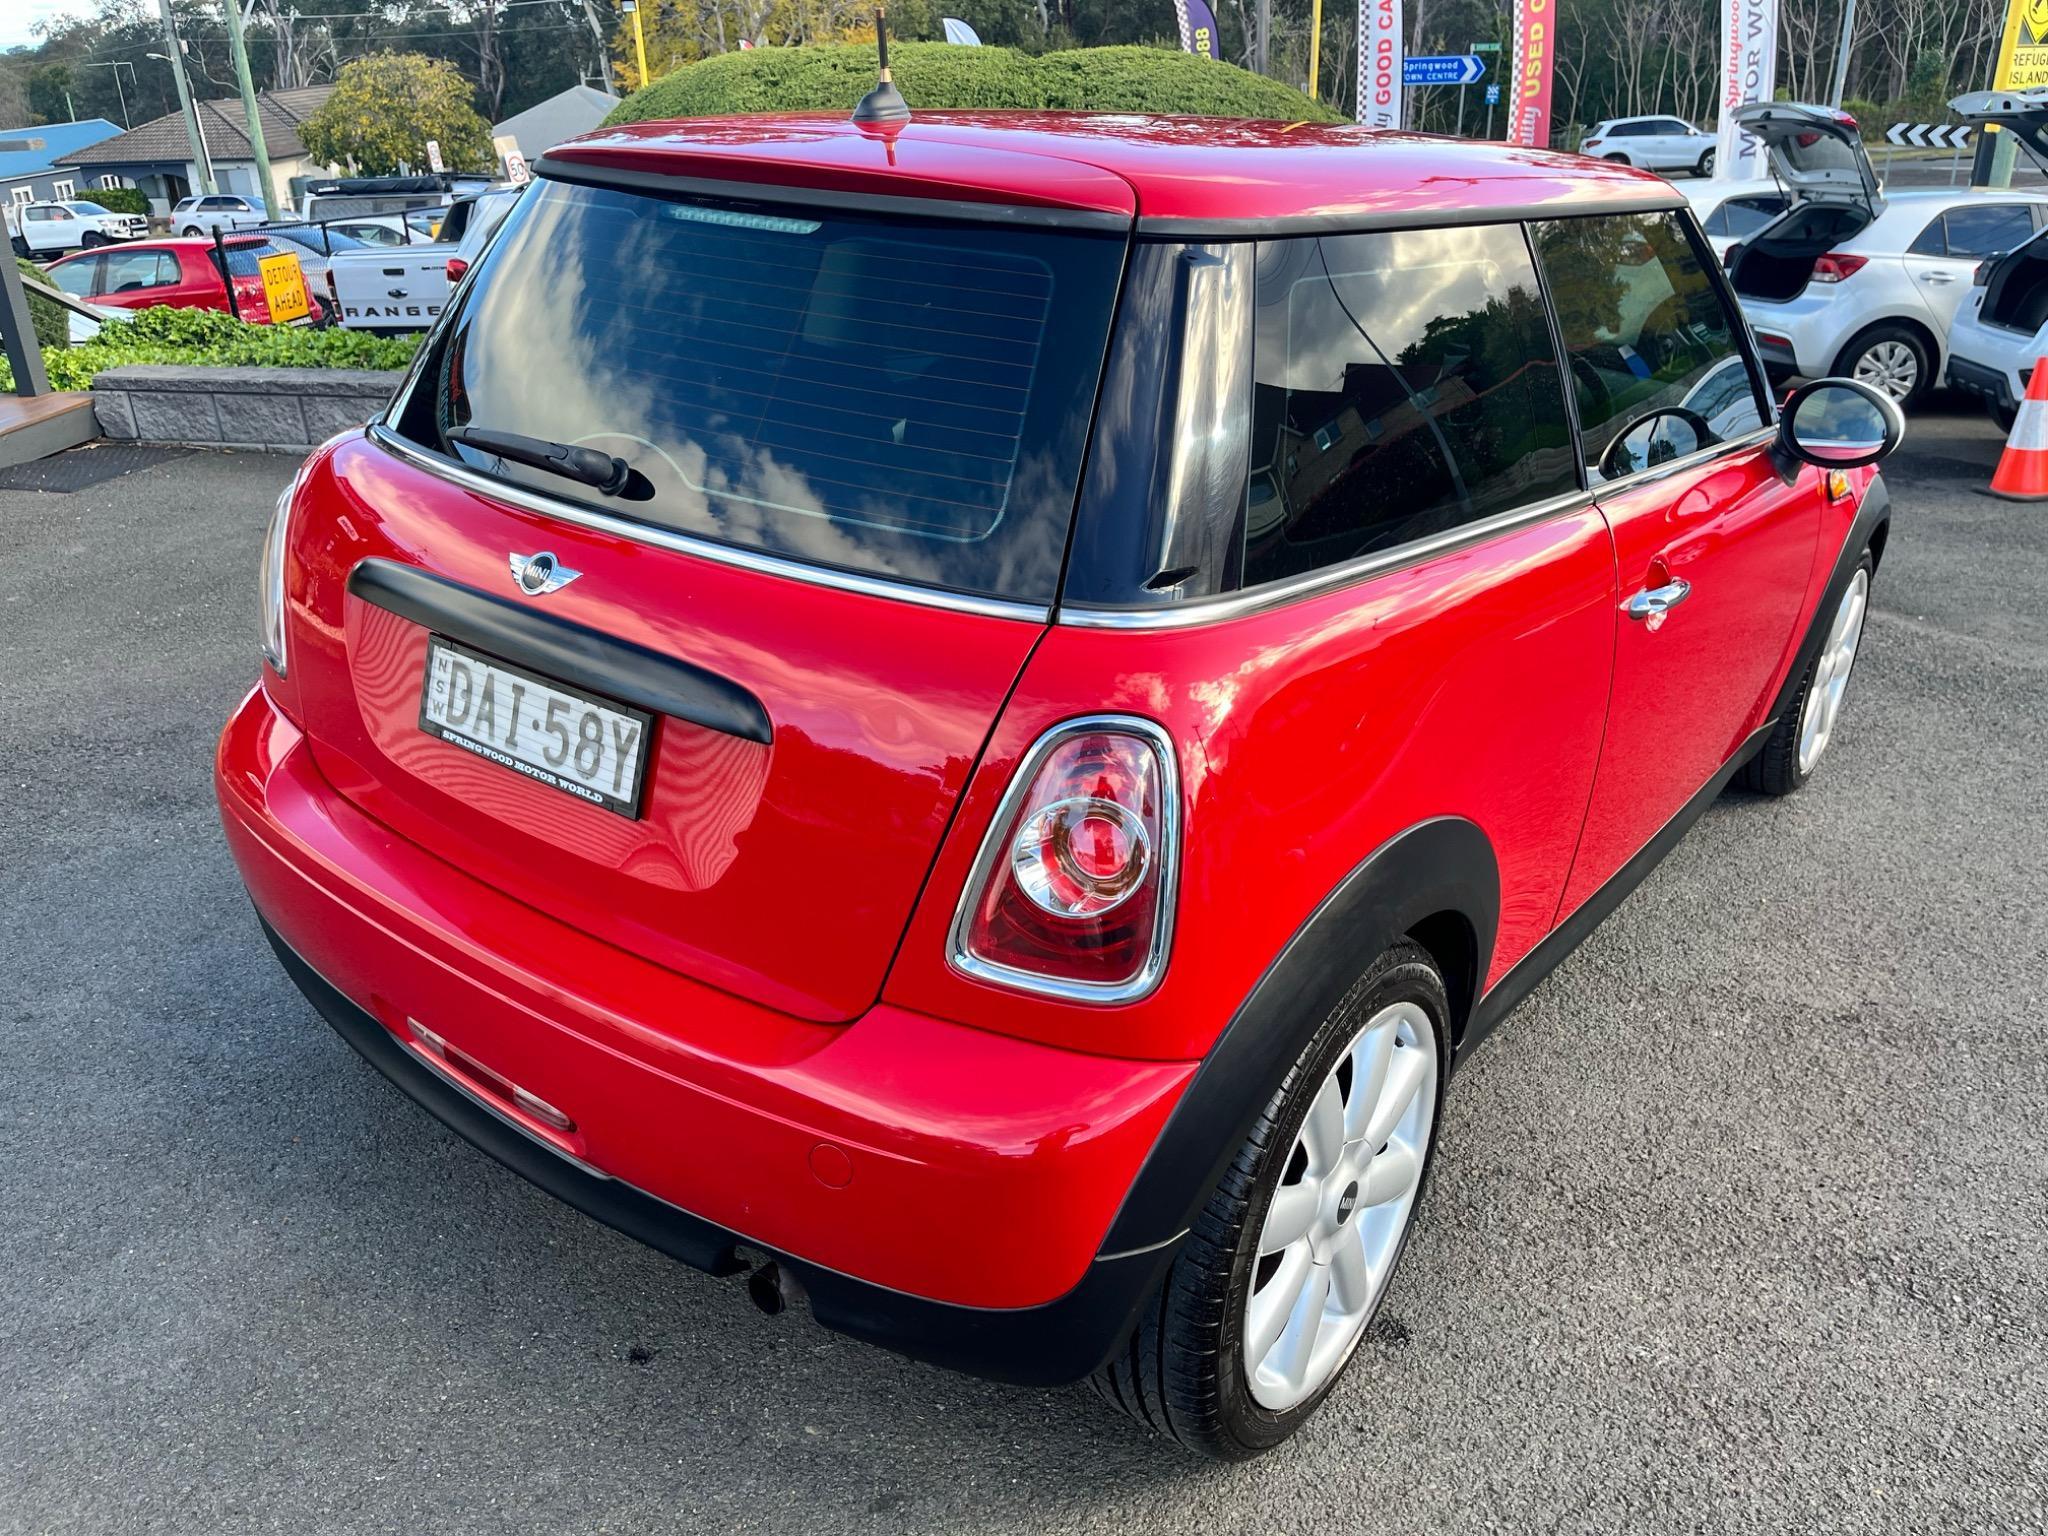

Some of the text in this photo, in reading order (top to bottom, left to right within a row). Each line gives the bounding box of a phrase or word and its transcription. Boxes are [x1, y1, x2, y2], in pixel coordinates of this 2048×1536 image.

[1376, 38, 1393, 105] GOOD
[1404, 61, 1459, 72] Springwood
[1524, 22, 1544, 98] USED
[1404, 72, 1459, 81] OWN CENTRE
[1739, 50, 1761, 160] MTOR
[266, 264, 298, 287] DETOUR
[275, 292, 303, 313] AHEAD
[525, 565, 551, 580] MINI
[443, 730, 603, 803] SPRINGWOOD MOTOR WORLD
